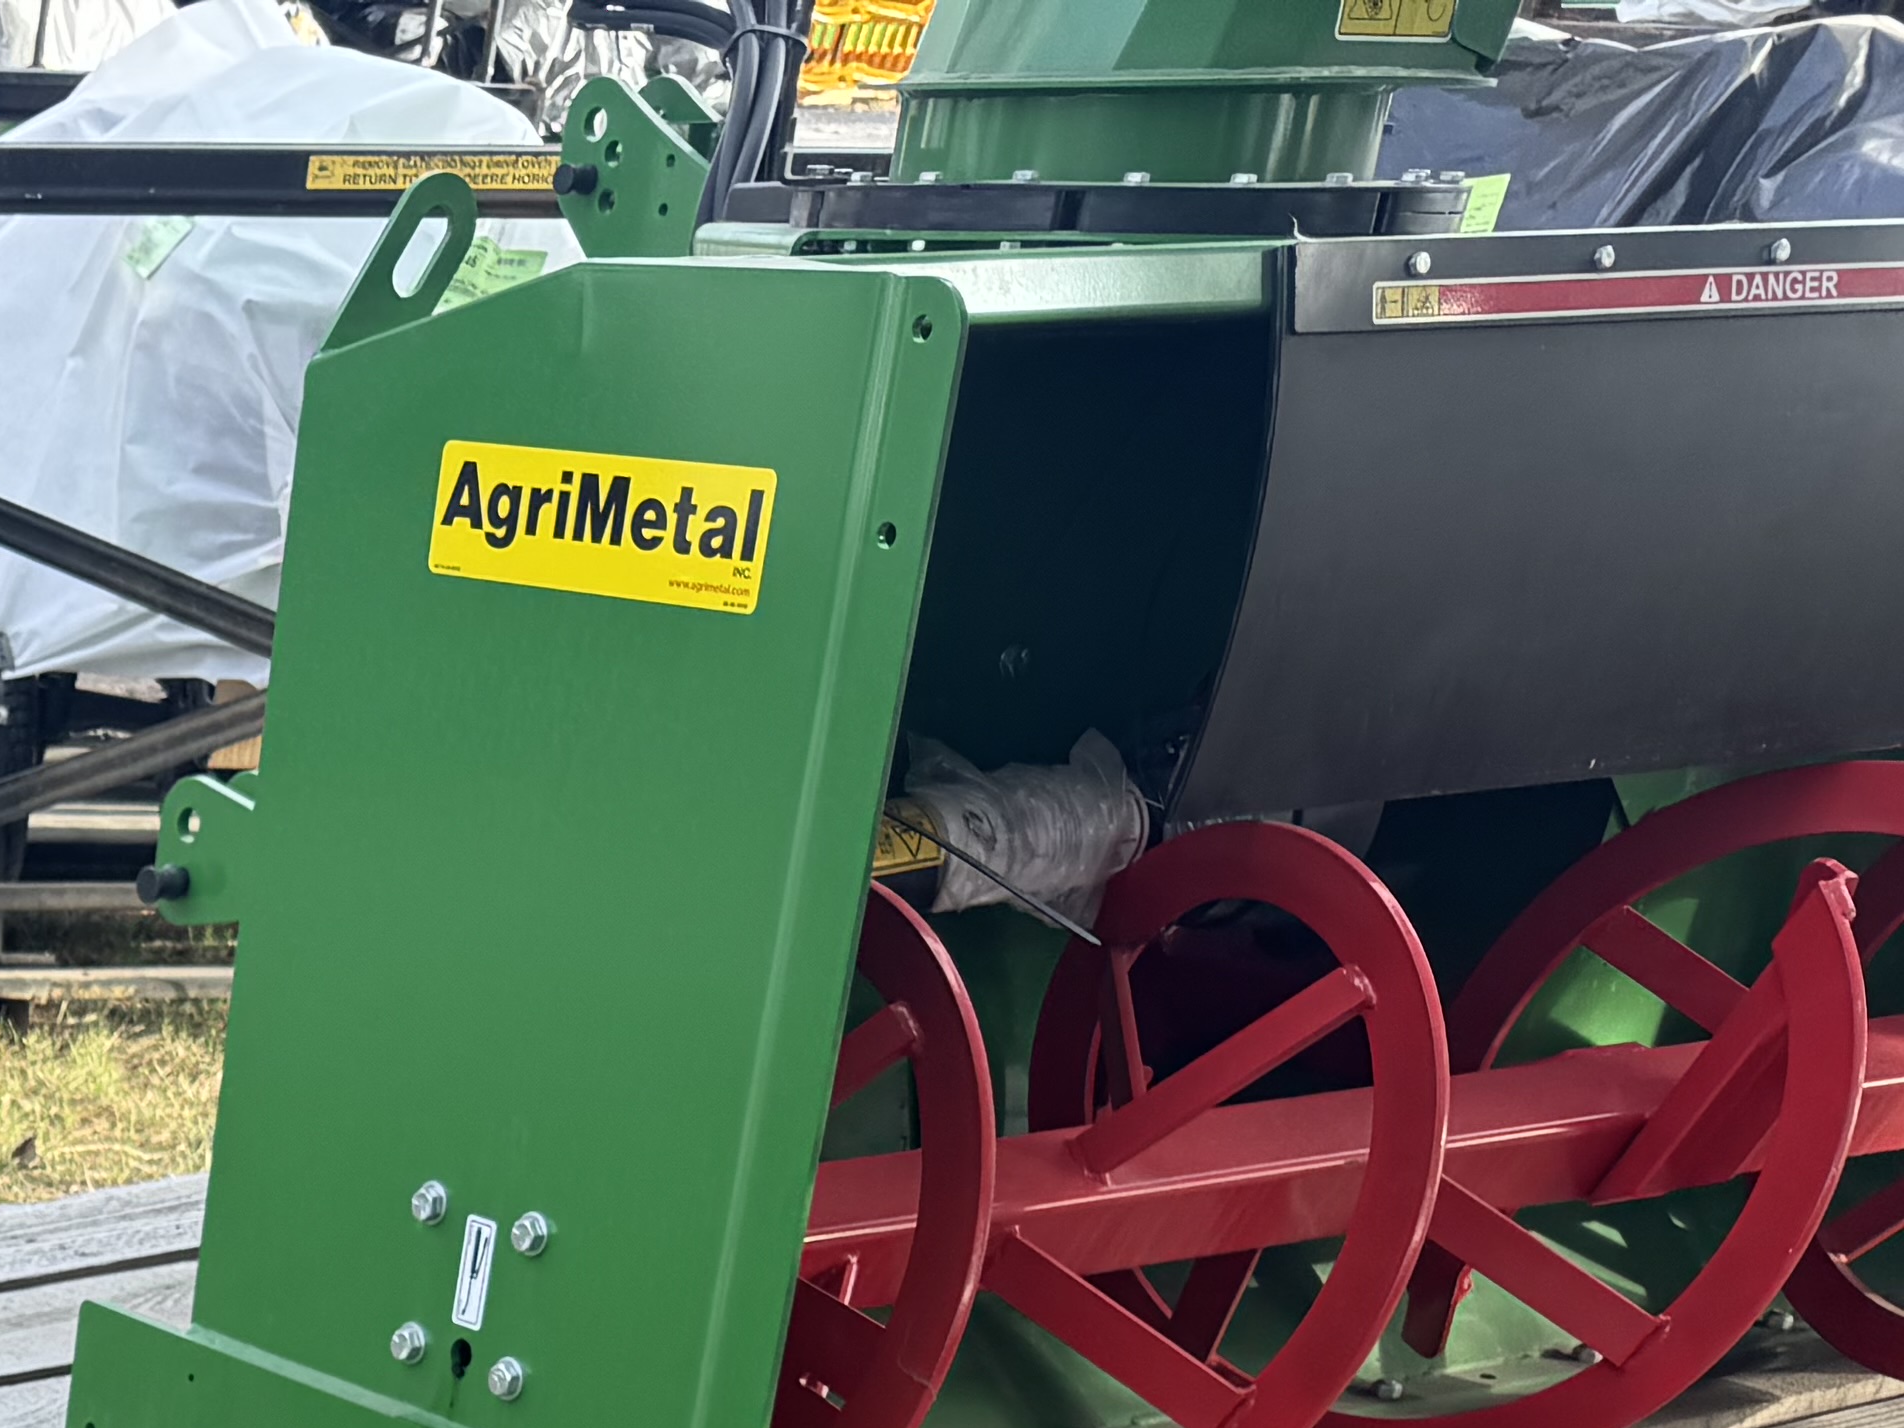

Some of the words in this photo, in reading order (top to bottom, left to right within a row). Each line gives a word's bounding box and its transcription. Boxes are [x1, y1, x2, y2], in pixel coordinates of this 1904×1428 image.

[342, 173, 398, 185] RETURN
[1729, 270, 1839, 301] DANGER
[440, 460, 765, 562] AgriMetal
[668, 579, 751, 596] www.agrimetal.com
